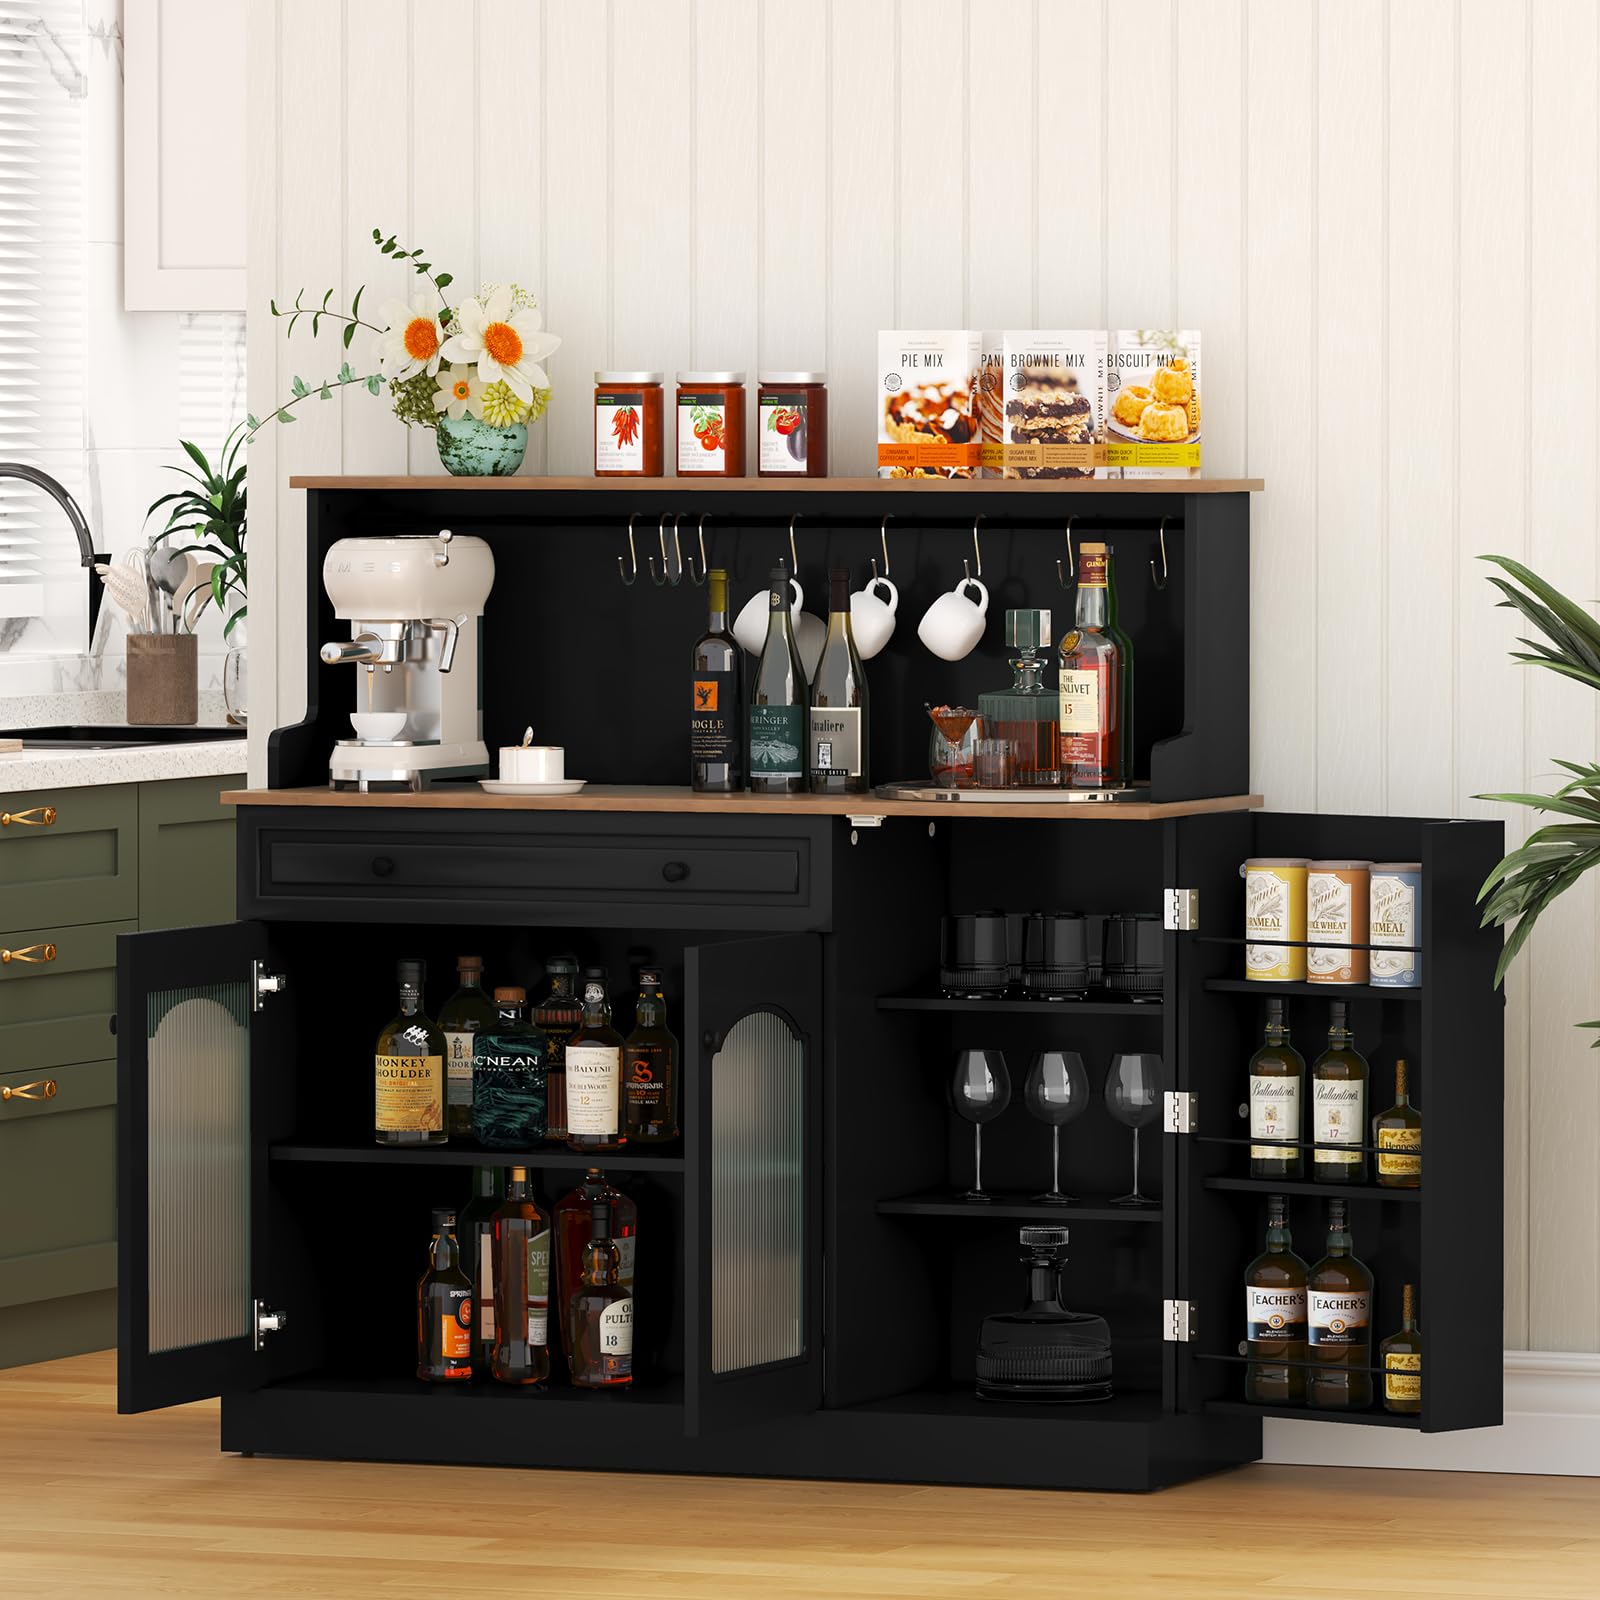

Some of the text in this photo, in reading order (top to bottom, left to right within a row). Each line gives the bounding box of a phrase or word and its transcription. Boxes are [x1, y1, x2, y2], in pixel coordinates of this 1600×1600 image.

[901, 353, 943, 368] PIE MIX
[1011, 353, 1085, 368] BROWNIE MIX
[1107, 353, 1176, 368] BISCUIT MIX
[1063, 675, 1074, 683] THE
[1064, 703, 1074, 714] 15
[1321, 921, 1348, 931] WHEAT
[377, 1057, 427, 1068] MONKEY
[1252, 1078, 1296, 1098] Ballantine's
[1315, 1082, 1359, 1102] Ballantine's
[580, 1095, 590, 1105] 12
[1265, 1125, 1276, 1135] 17
[1329, 1129, 1339, 1138] 17
[1252, 1291, 1305, 1308] TEACHER'S
[1312, 1295, 1367, 1312] TEACHER'S
[606, 1335, 618, 1347] 18
